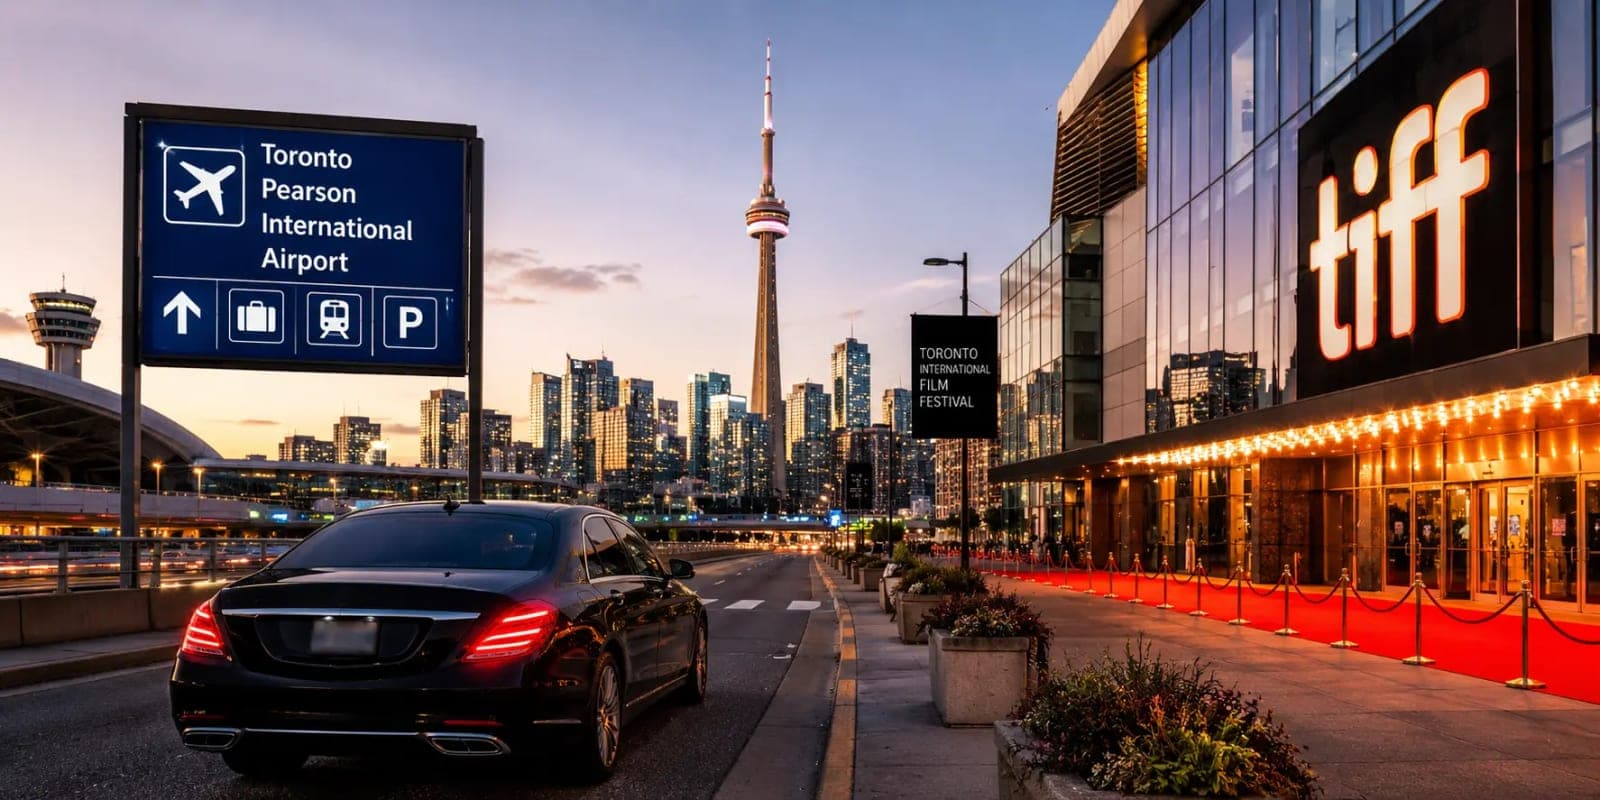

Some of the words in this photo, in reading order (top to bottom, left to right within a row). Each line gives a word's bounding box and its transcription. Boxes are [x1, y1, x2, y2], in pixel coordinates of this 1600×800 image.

[261, 143, 352, 169] Toronto
[263, 178, 355, 203] Pearson
[263, 213, 412, 240] International
[1310, 68, 1490, 361] tiff
[262, 248, 348, 275] Airport
[400, 306, 423, 338] P
[919, 347, 978, 360] TORONTO
[919, 363, 990, 375] INTERNATIONAL
[919, 378, 949, 392] FILM
[919, 395, 974, 408] FESTIVAL
